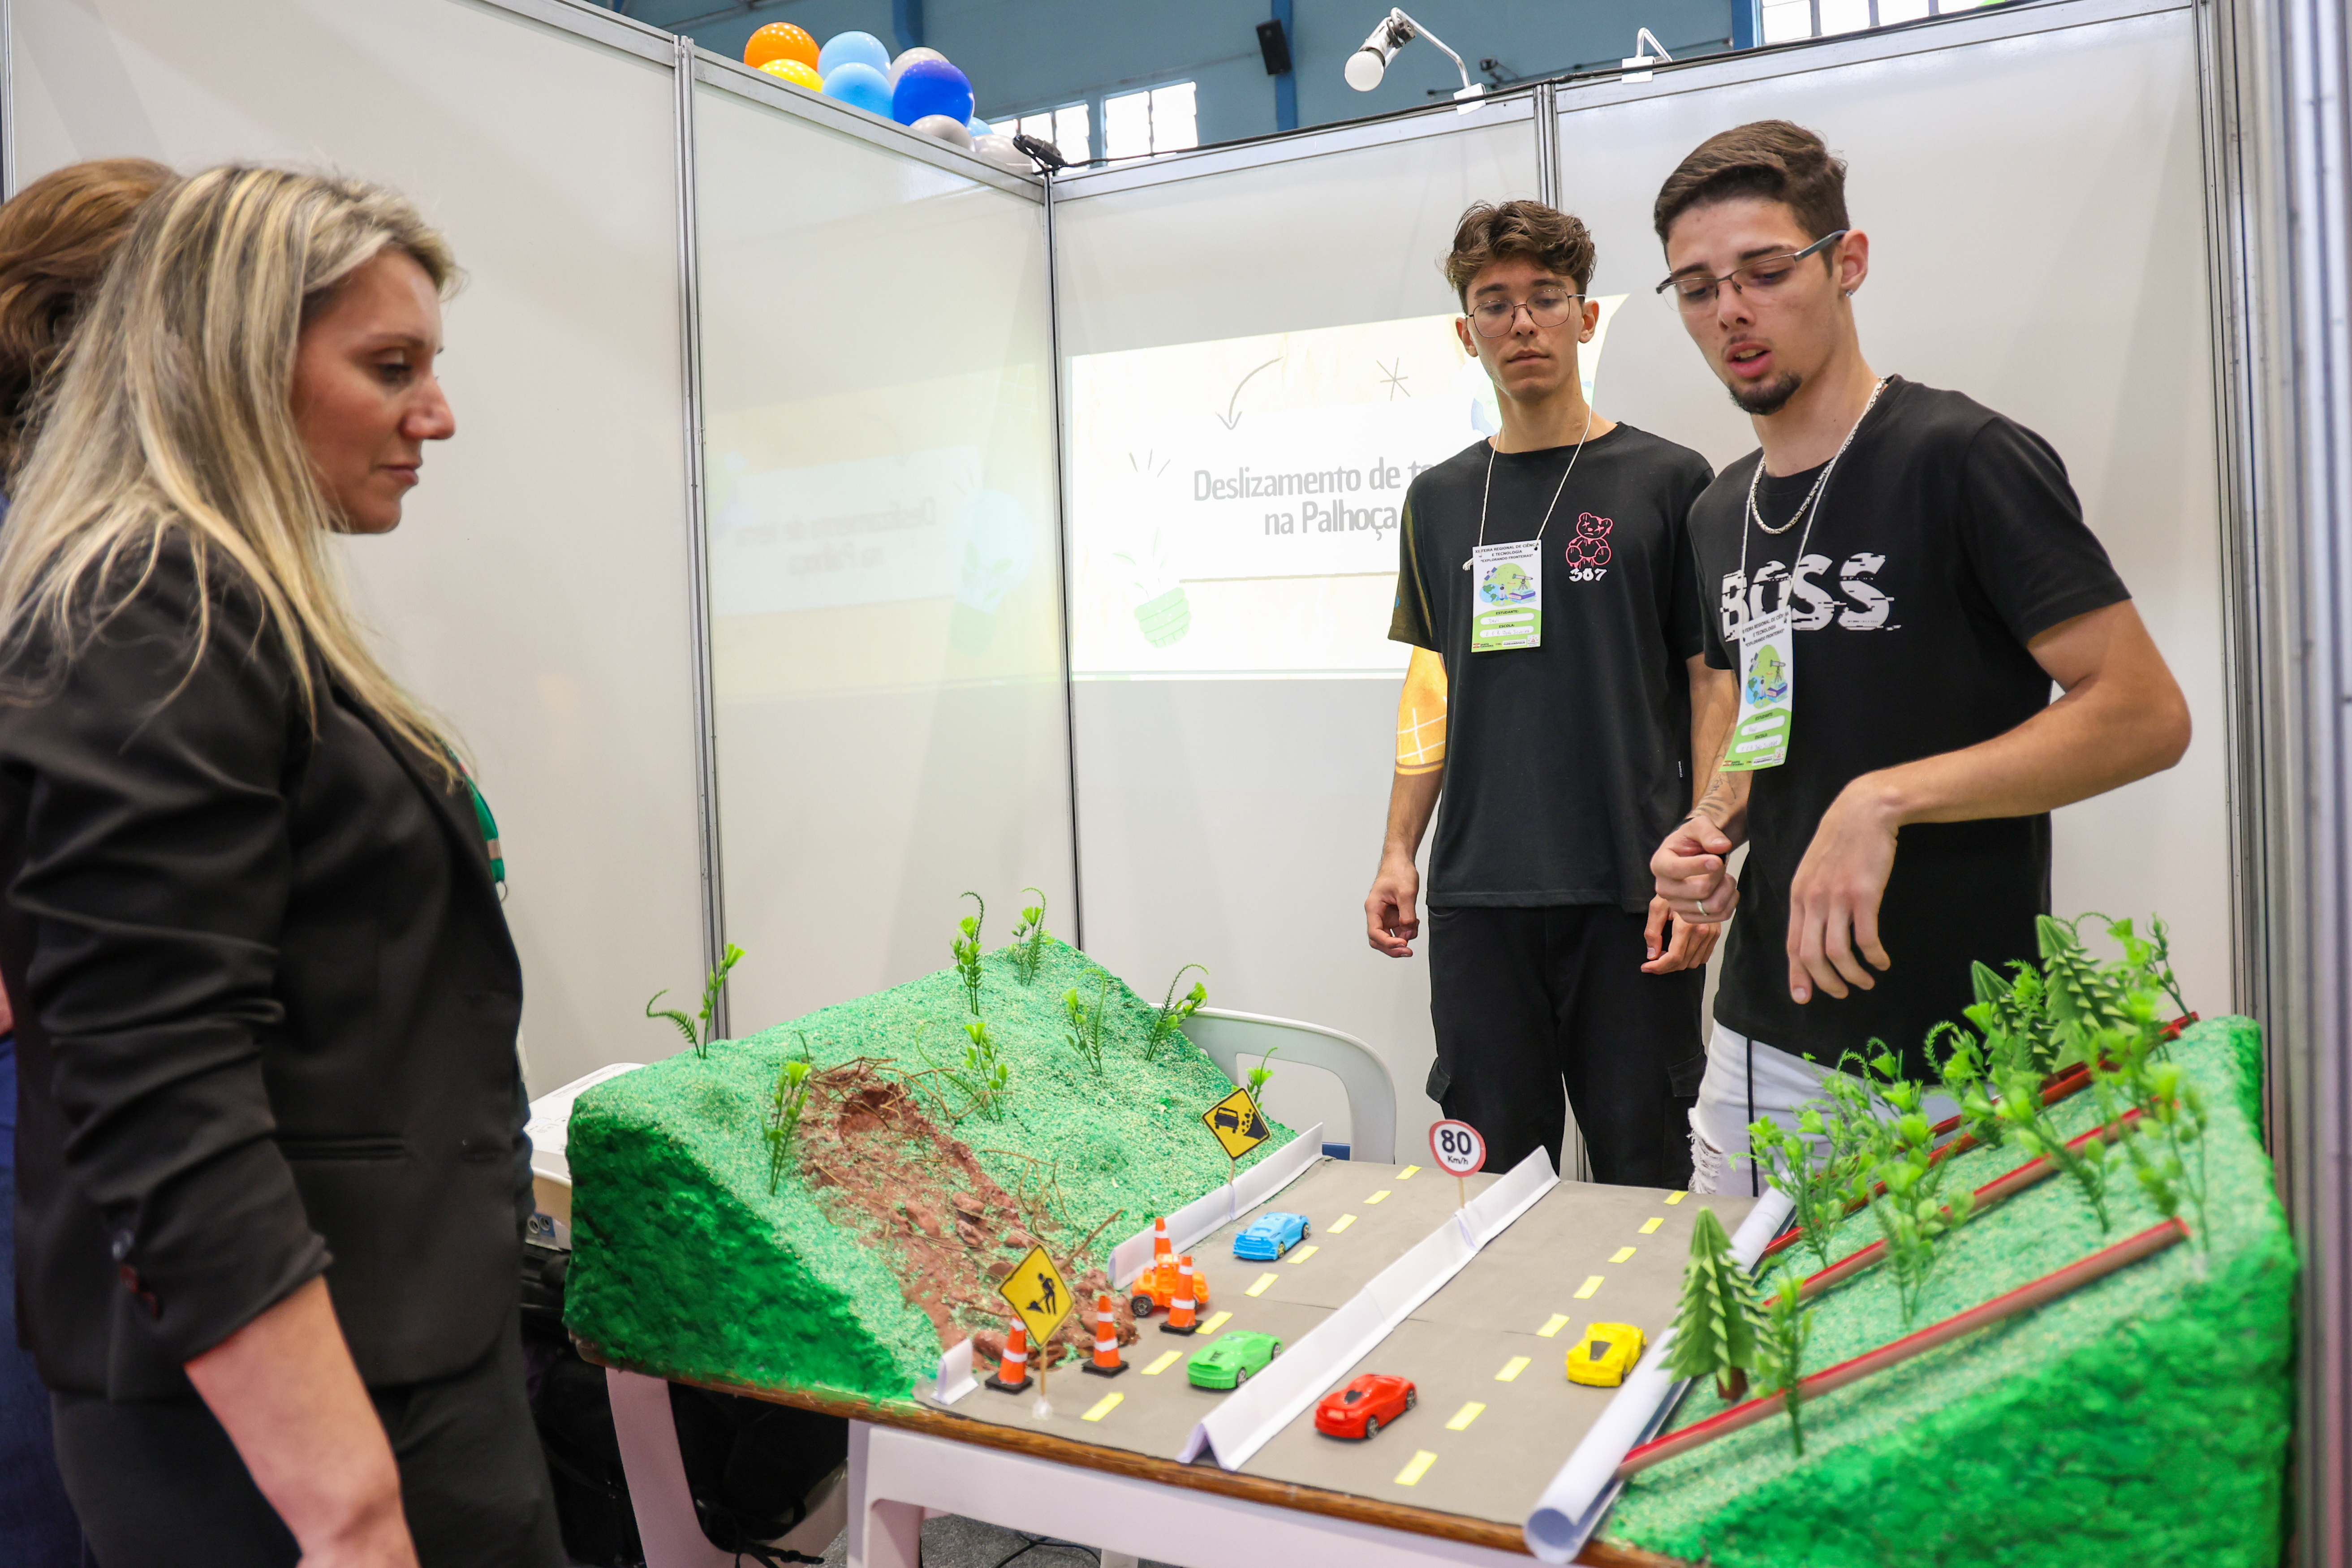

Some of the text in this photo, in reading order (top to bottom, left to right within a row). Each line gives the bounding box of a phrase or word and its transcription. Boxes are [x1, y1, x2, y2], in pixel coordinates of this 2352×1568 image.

[1194, 466, 1361, 501] Deslizamento
[1369, 457, 1401, 490] de
[1265, 499, 1397, 541] na Palhoça
[1719, 552, 1900, 642] BOSS
[1441, 1129, 1472, 1155] 80
[1447, 1155, 1469, 1165] Km/h
